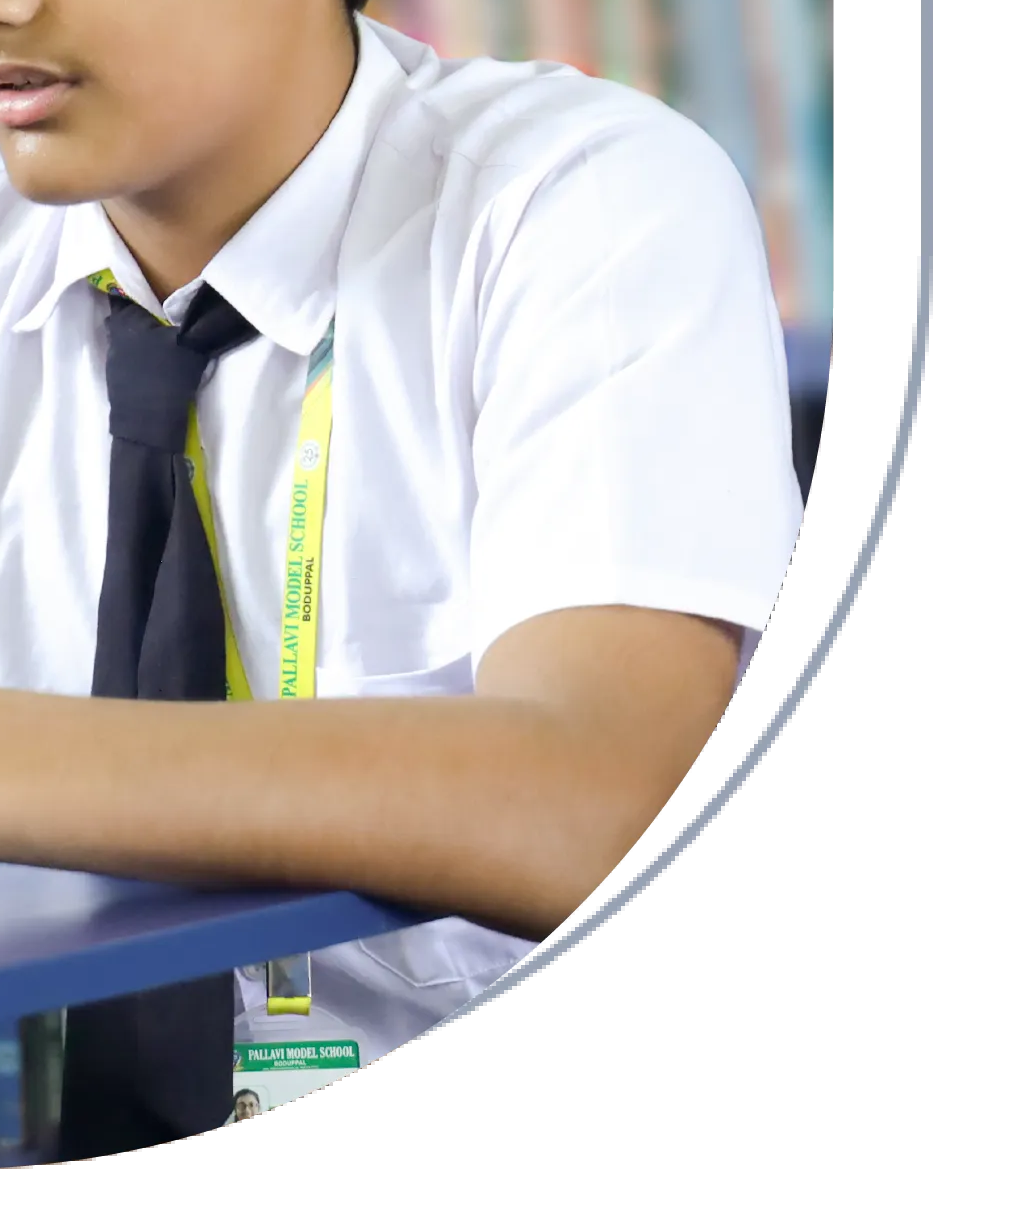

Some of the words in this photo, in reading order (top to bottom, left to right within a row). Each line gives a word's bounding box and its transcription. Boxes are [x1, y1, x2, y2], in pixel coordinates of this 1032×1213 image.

[289, 479, 308, 552] SCHOOL
[285, 556, 303, 620] MODEL
[302, 557, 314, 622] BODUPPAL
[281, 624, 299, 698] PALLAVI
[248, 1048, 285, 1061] PALLAVI
[286, 1046, 318, 1059] MODEL
[319, 1045, 355, 1058] SCHOOL
